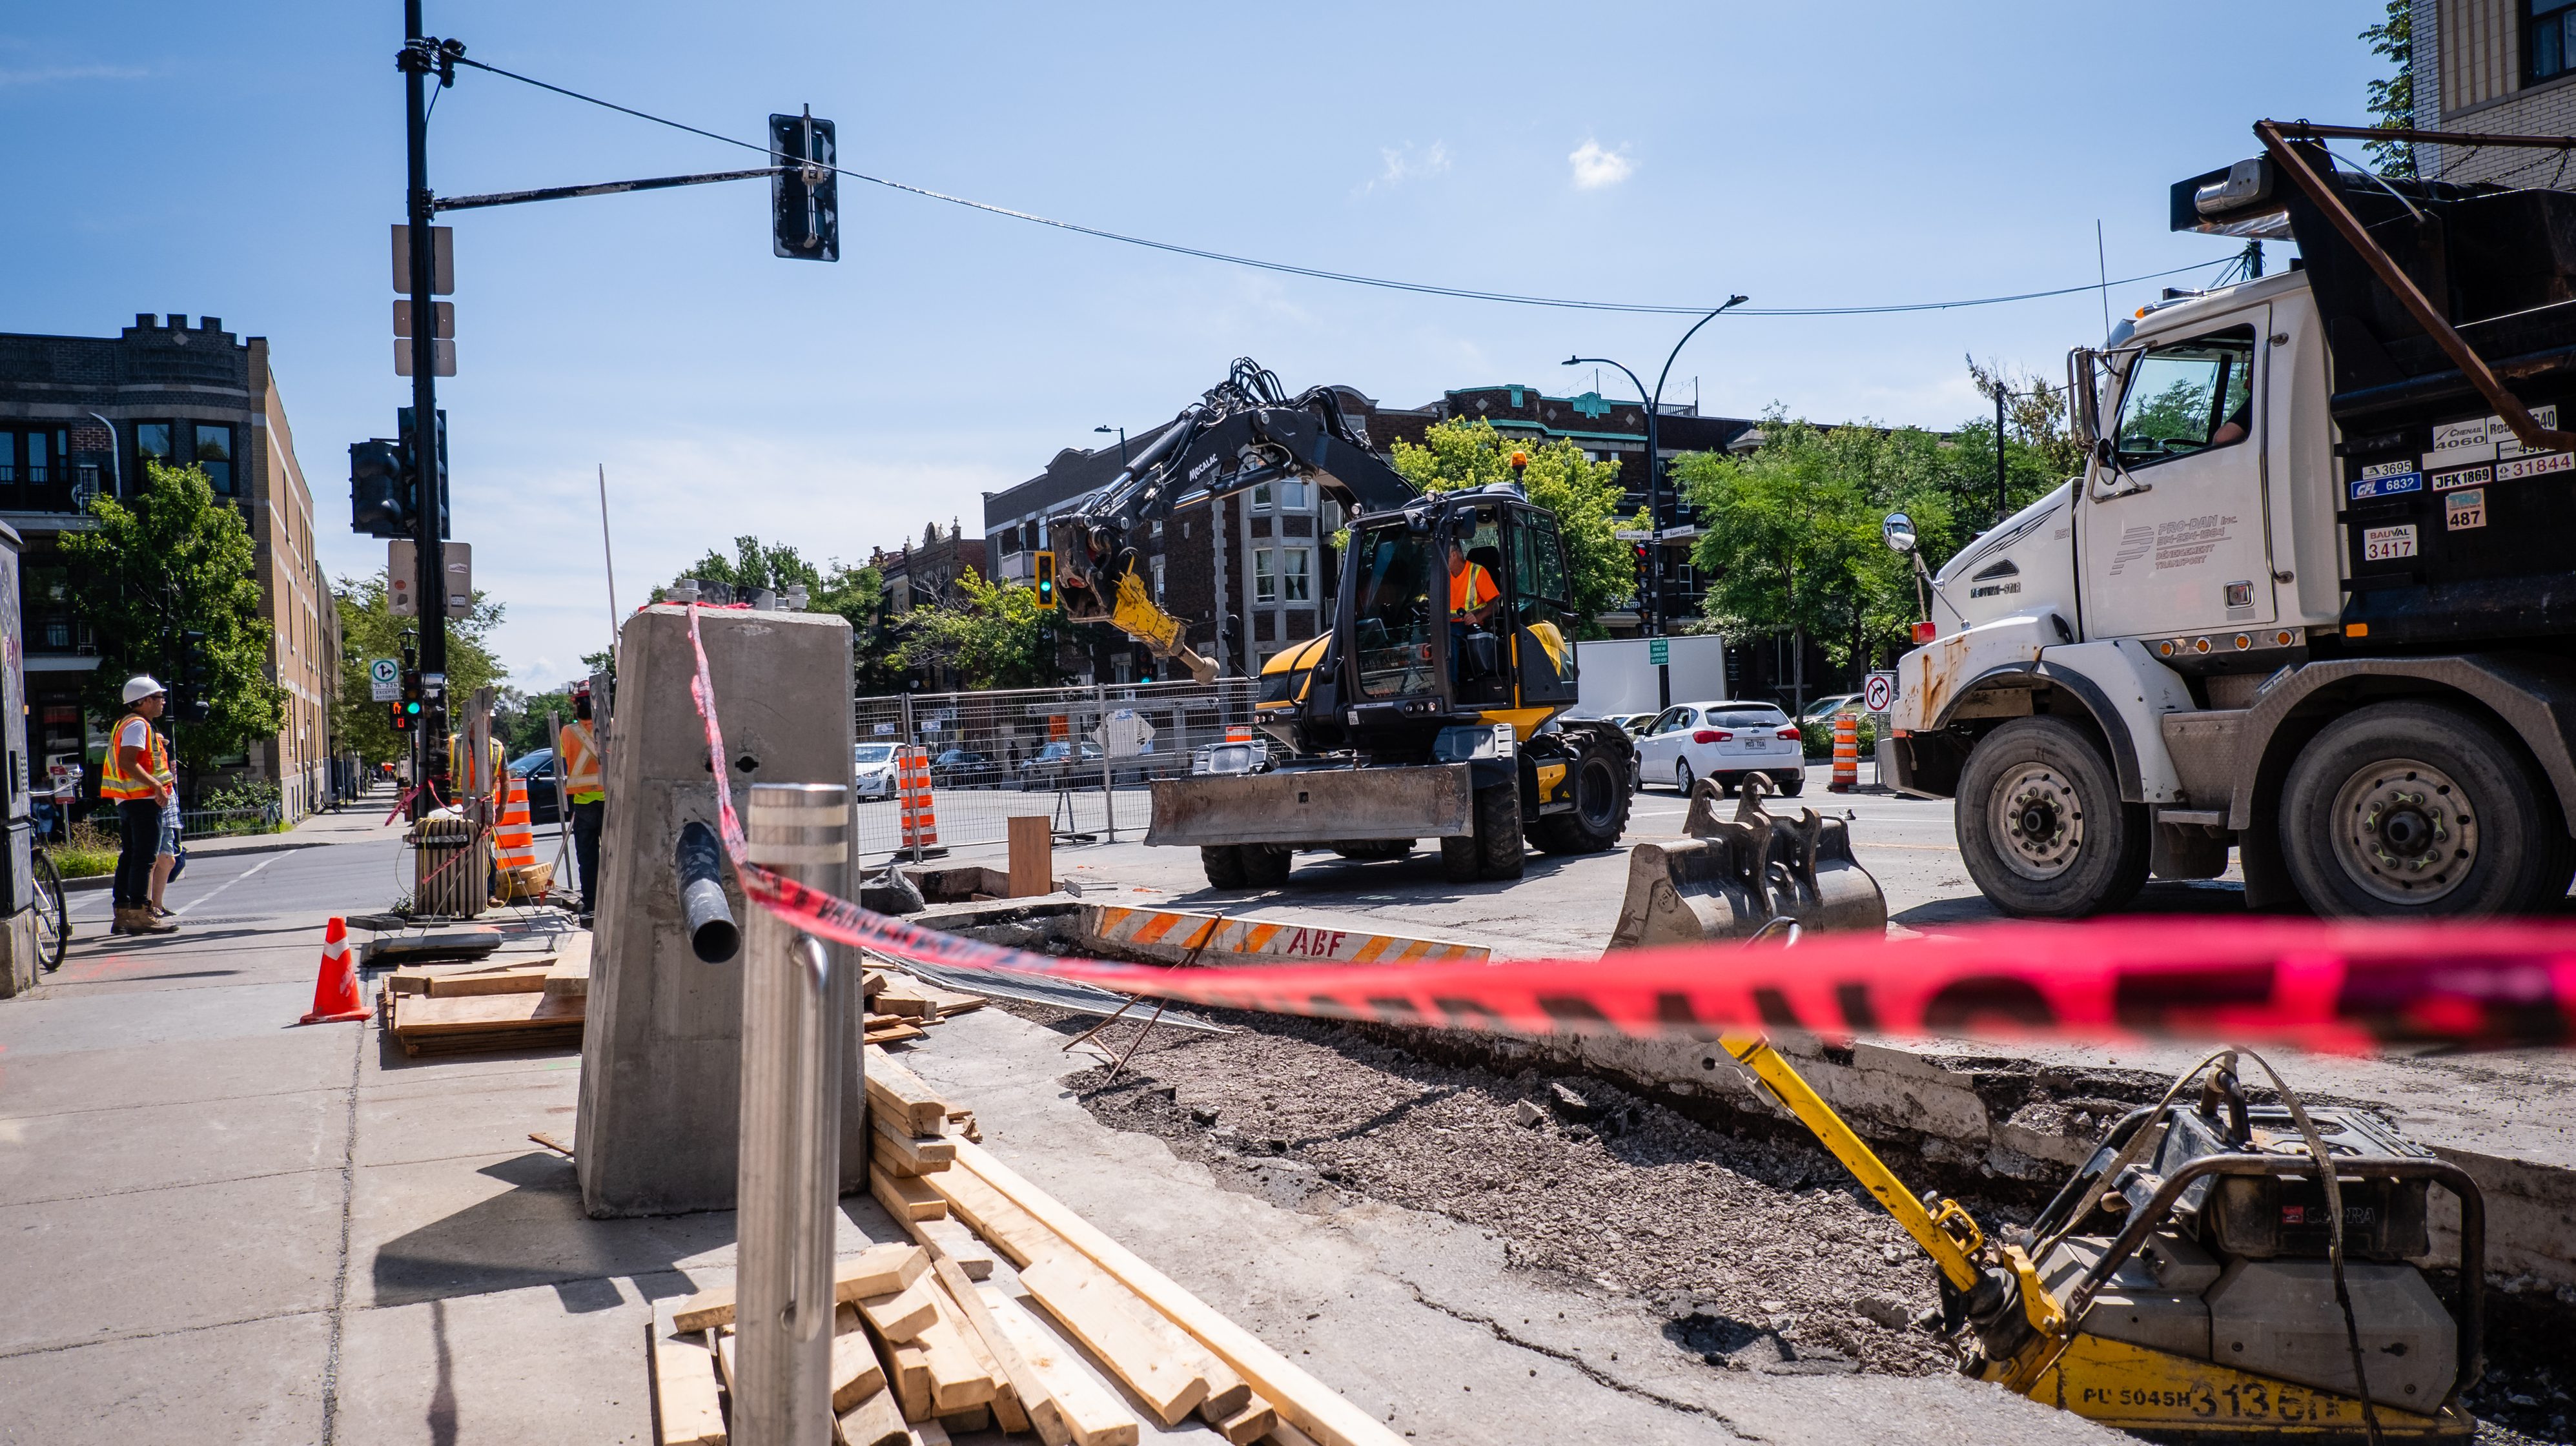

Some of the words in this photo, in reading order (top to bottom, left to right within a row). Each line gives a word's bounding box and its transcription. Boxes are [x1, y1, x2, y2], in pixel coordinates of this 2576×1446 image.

[2449, 427, 2483, 437] CHENAIL
[2435, 436, 2485, 449] 4060
[2382, 461, 2411, 475] 3695
[2513, 455, 2571, 476] 31844
[2435, 473, 2461, 488] JFK
[2462, 469, 2489, 483] 1869
[2158, 514, 2218, 535] PRO-DAN
[2449, 510, 2480, 527] 487
[2370, 527, 2410, 539] BAUVAL
[2369, 541, 2411, 559] 3417
[2156, 555, 2207, 569] TRANSPORT
[1287, 927, 1346, 957] ABF
